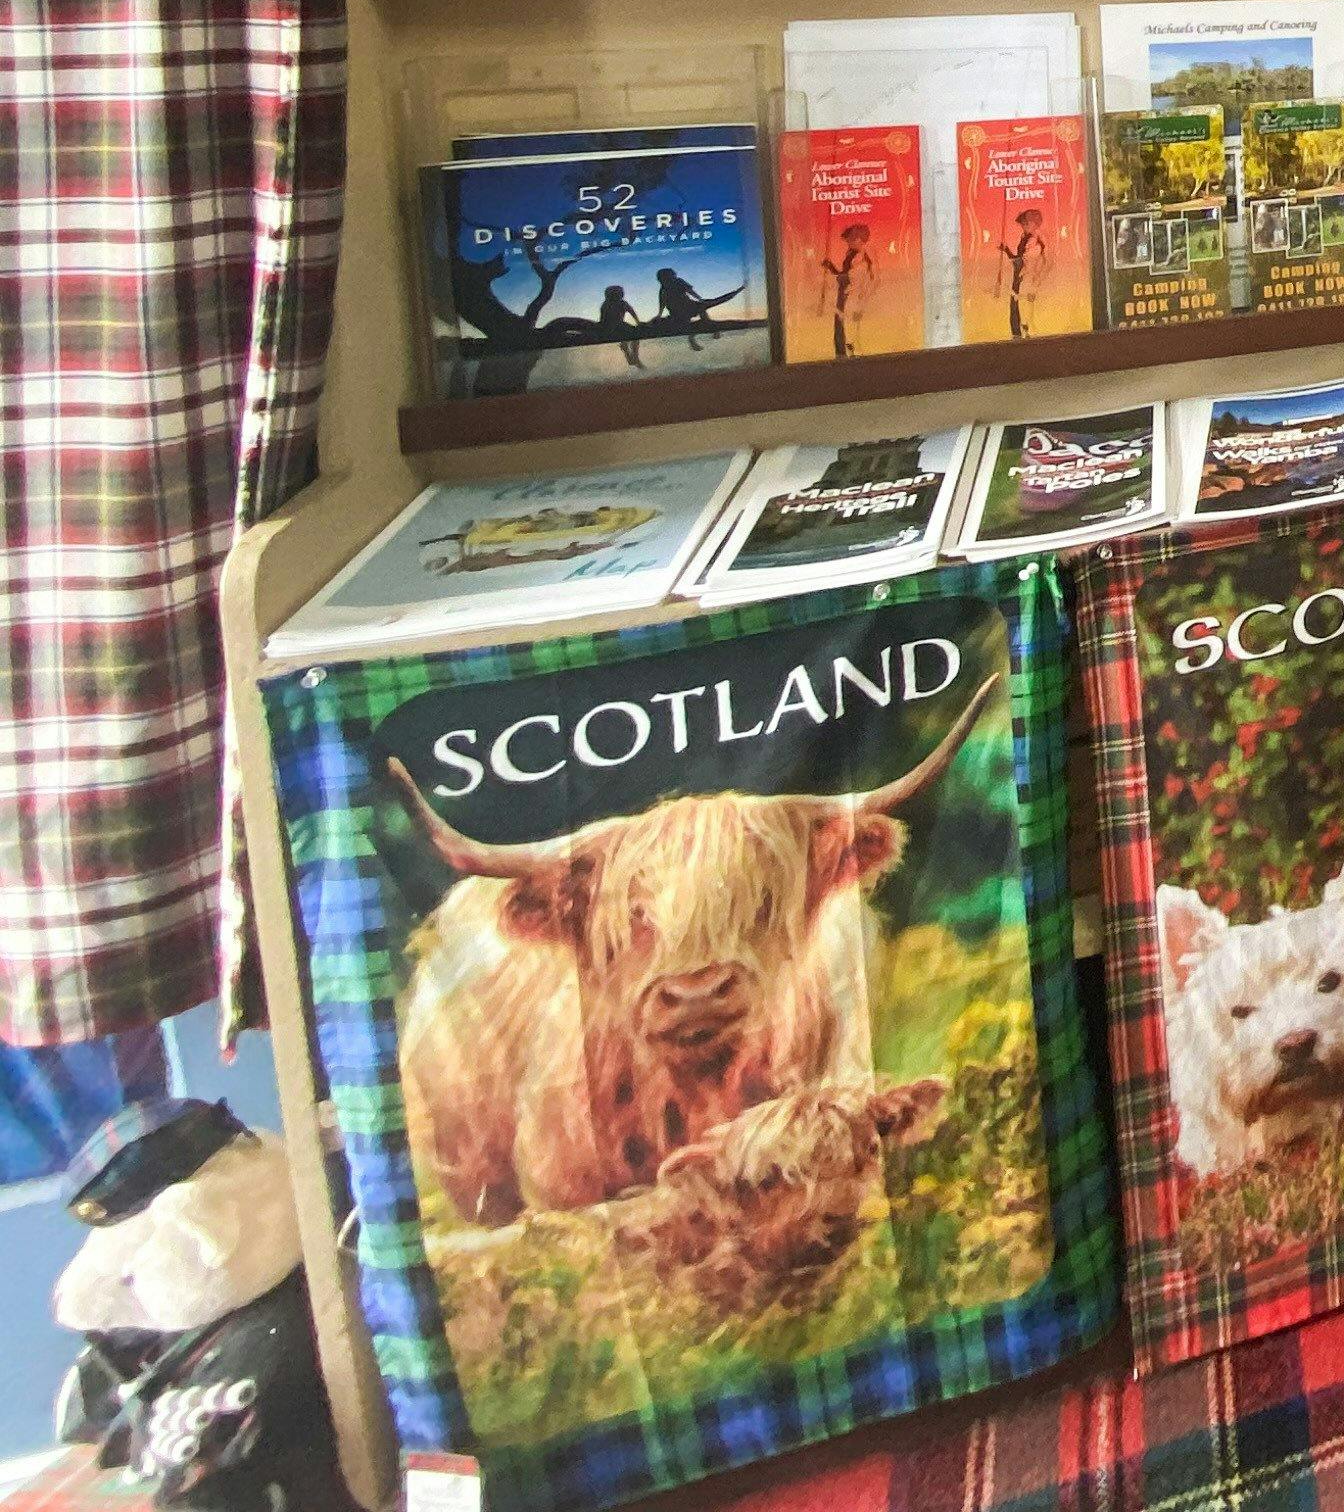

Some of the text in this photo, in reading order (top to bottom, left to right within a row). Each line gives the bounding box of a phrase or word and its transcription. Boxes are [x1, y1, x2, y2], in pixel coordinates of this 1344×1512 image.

[1144, 20, 1318, 36] Michaels Camping and Canoeing
[987, 157, 1059, 175] Aboriginal
[811, 168, 888, 187] Aboriginal
[985, 173, 1034, 188] Tourist
[578, 183, 637, 213] 52
[811, 184, 892, 202] Tourist Site
[1005, 187, 1045, 201] Drive
[829, 200, 873, 216] Drive
[474, 208, 737, 245] DISCOVERIES
[580, 240, 611, 250] BIG
[621, 231, 713, 247] BACKYARD
[1270, 261, 1341, 280] Camping
[1133, 277, 1208, 297] Camping
[1263, 281, 1305, 299] BOOK
[1125, 292, 1216, 317] BOOK NOW
[1212, 445, 1292, 461] Walks
[1008, 449, 1143, 478] Maclean
[786, 472, 936, 502] Maclean
[781, 490, 903, 515] Heritage
[839, 493, 918, 519] Trail
[433, 637, 963, 799] SCOTLAND
